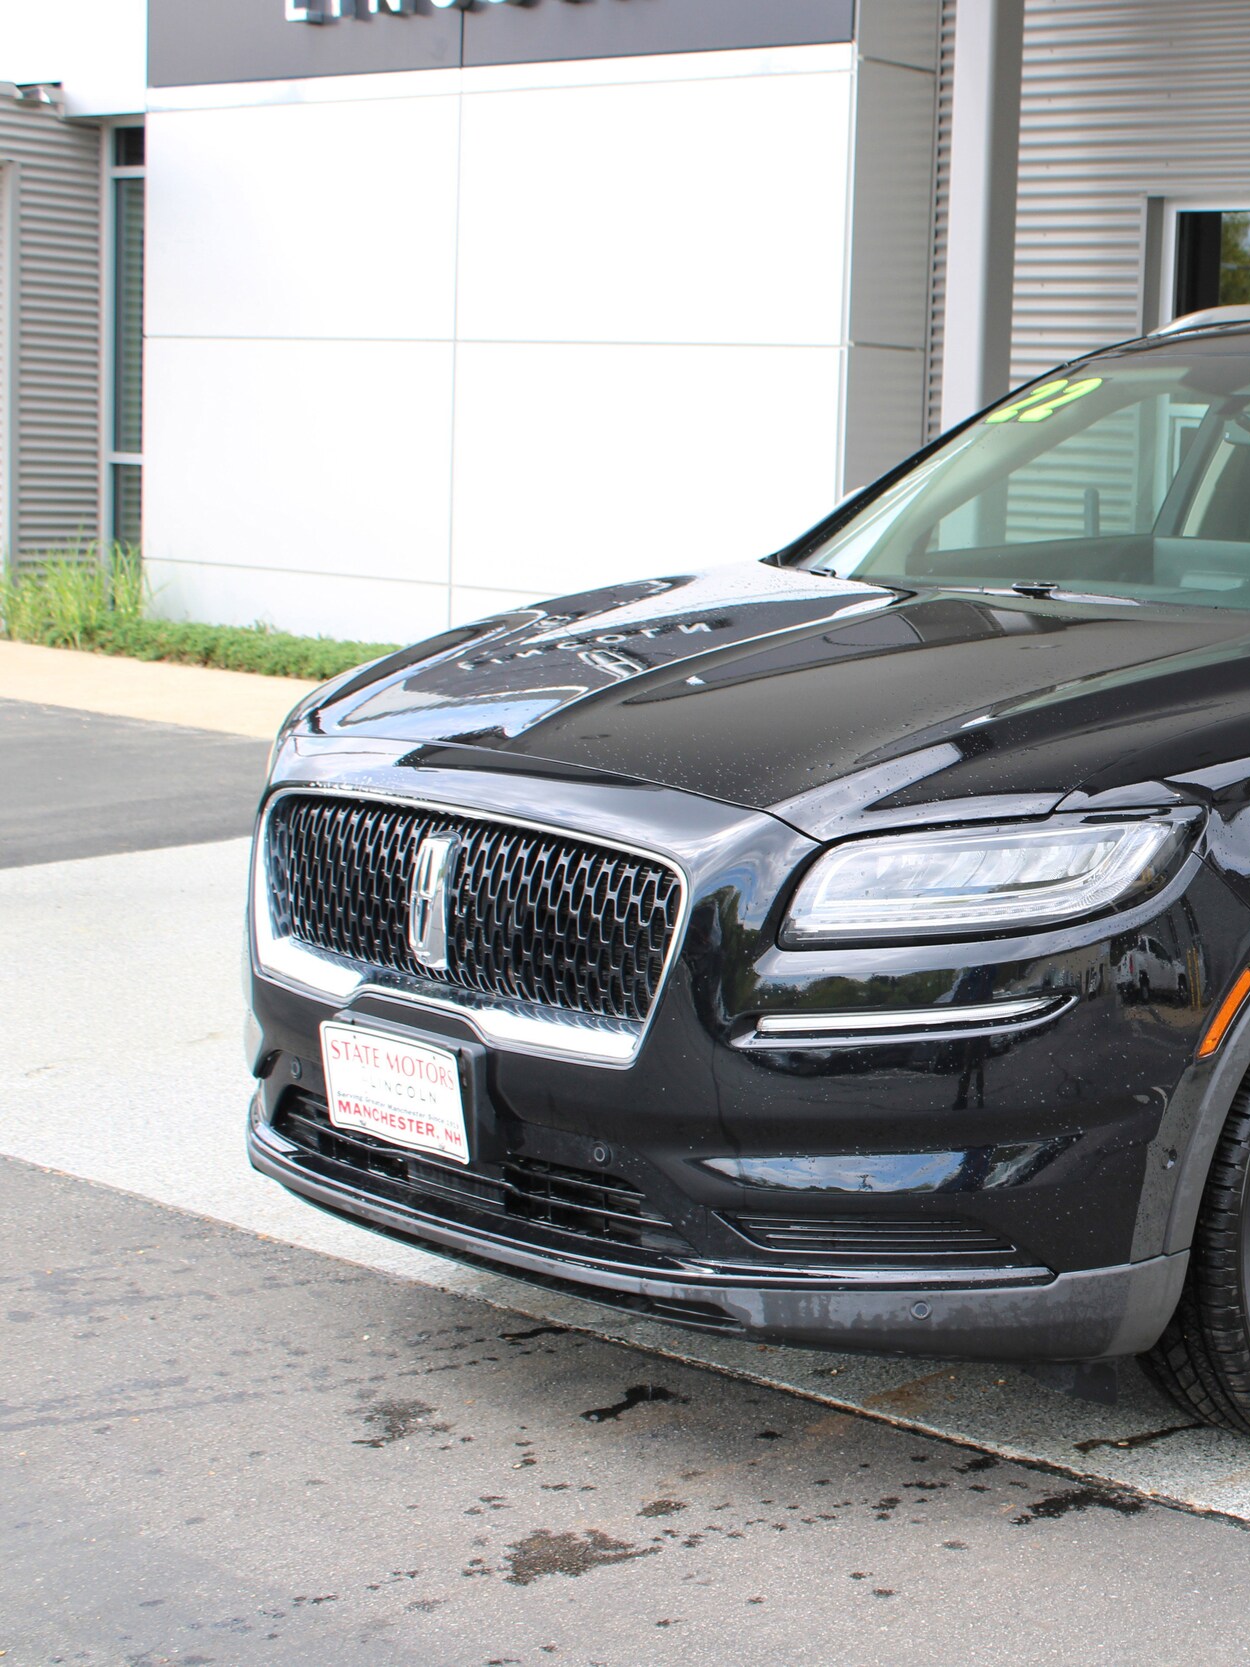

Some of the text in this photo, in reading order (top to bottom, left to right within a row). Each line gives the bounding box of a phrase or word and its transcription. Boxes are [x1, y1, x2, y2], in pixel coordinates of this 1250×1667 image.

[984, 377, 1103, 424] 22
[330, 1039, 455, 1091] STATE MOTORS
[370, 1075, 438, 1105] LINCOLN
[444, 1127, 462, 1147] NH
